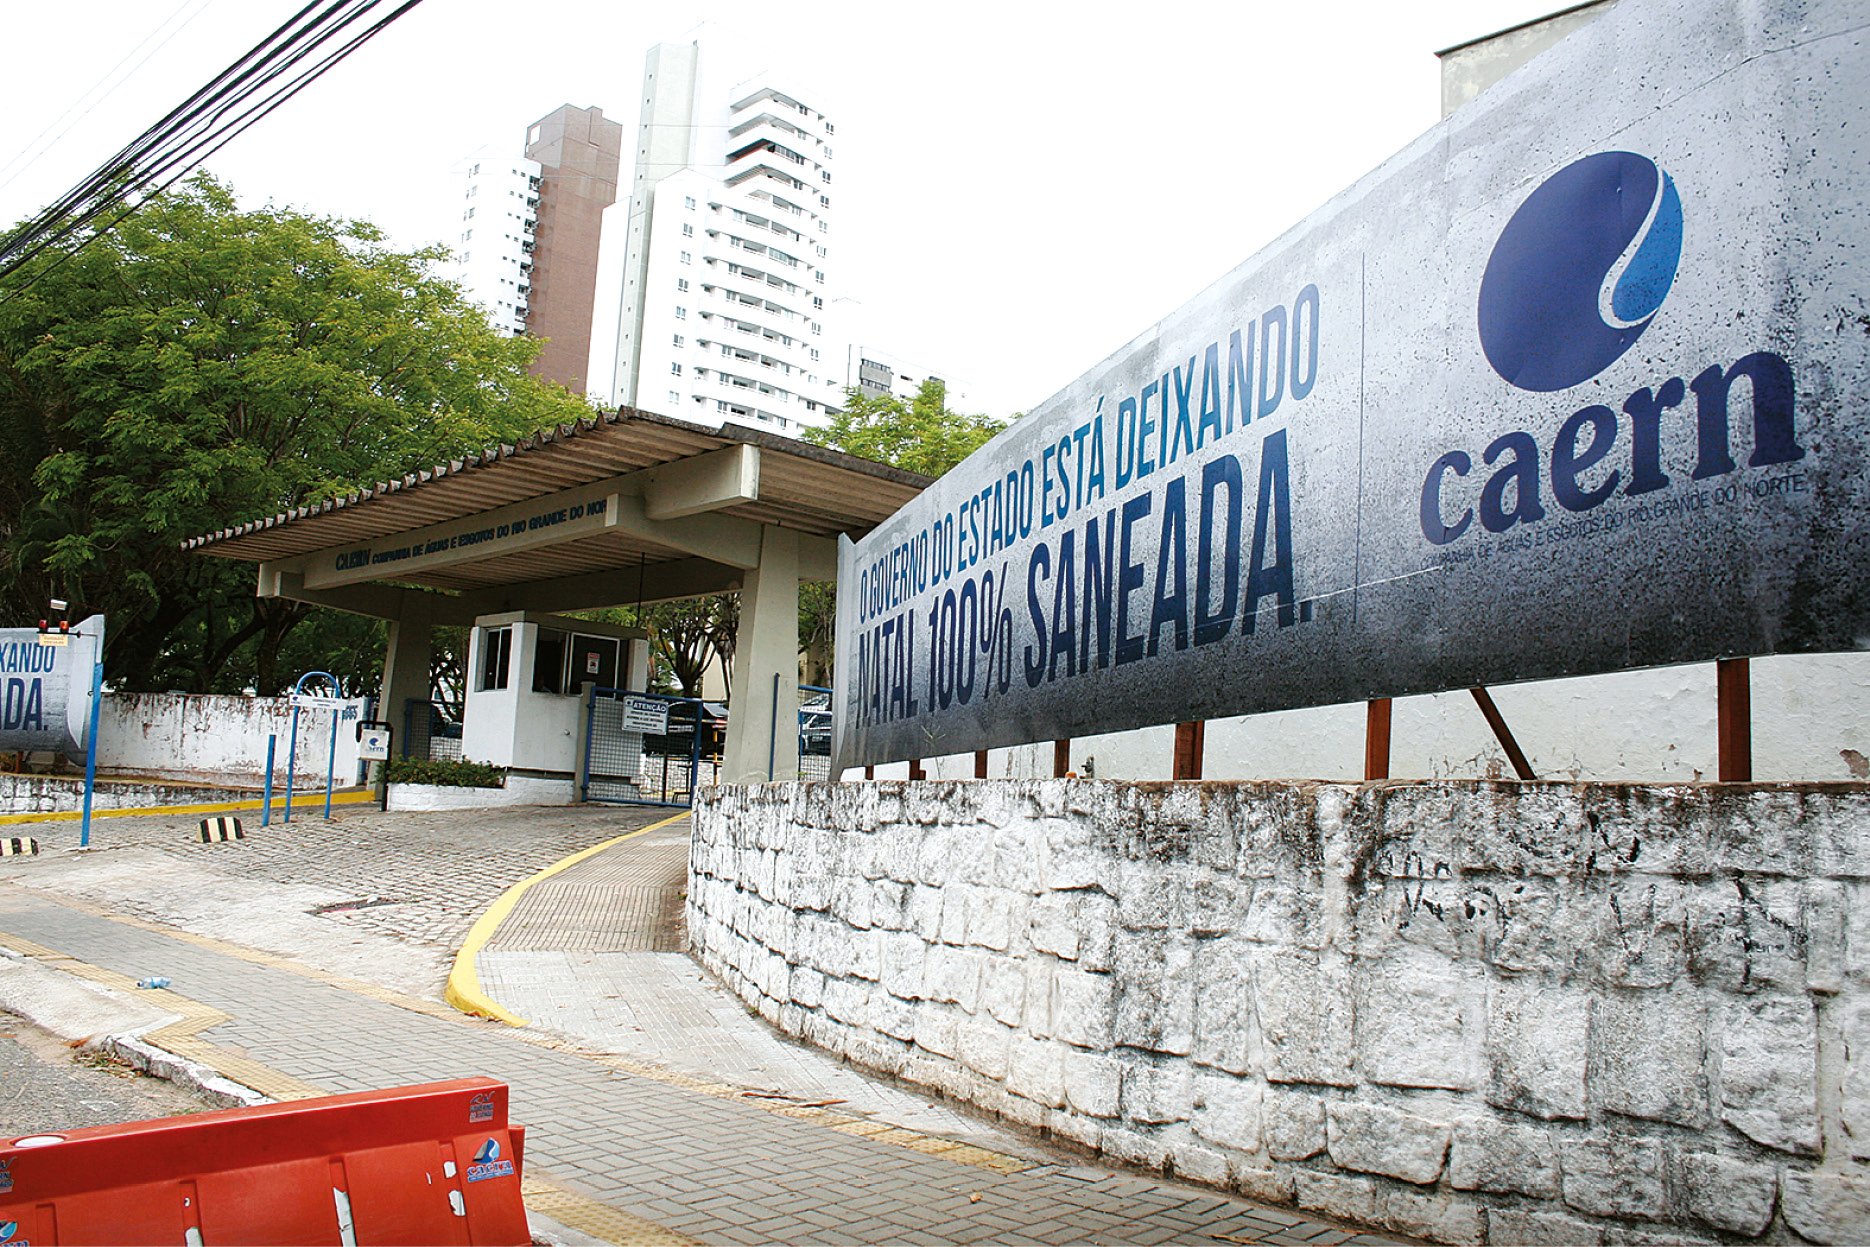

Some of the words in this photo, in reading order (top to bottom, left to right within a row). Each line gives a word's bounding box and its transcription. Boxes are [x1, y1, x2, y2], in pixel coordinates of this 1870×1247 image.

[861, 568, 868, 625] O
[869, 528, 928, 620] GOVERNO
[931, 512, 953, 587] DO
[957, 459, 1034, 573] ESTADO
[1040, 396, 1105, 530] ESTÁ
[1114, 282, 1320, 490] DEIXANDO
[1420, 351, 1805, 546] caern
[1546, 518, 1600, 544] ESGOTOS
[1605, 510, 1624, 530] DO
[1653, 489, 1709, 519] GRANDE
[1715, 484, 1738, 505] DO
[1744, 474, 1805, 499] NORTE
[412, 544, 424, 558] DE
[450, 536, 458, 549] E
[496, 524, 509, 539] DO
[511, 519, 526, 535] RIO
[528, 509, 567, 531] GRANDE
[569, 505, 584, 521] DO
[856, 608, 919, 730] NATAL
[928, 561, 1013, 713] 100%
[1024, 427, 1312, 689] SANEADA.
[0, 677, 49, 731] DA.
